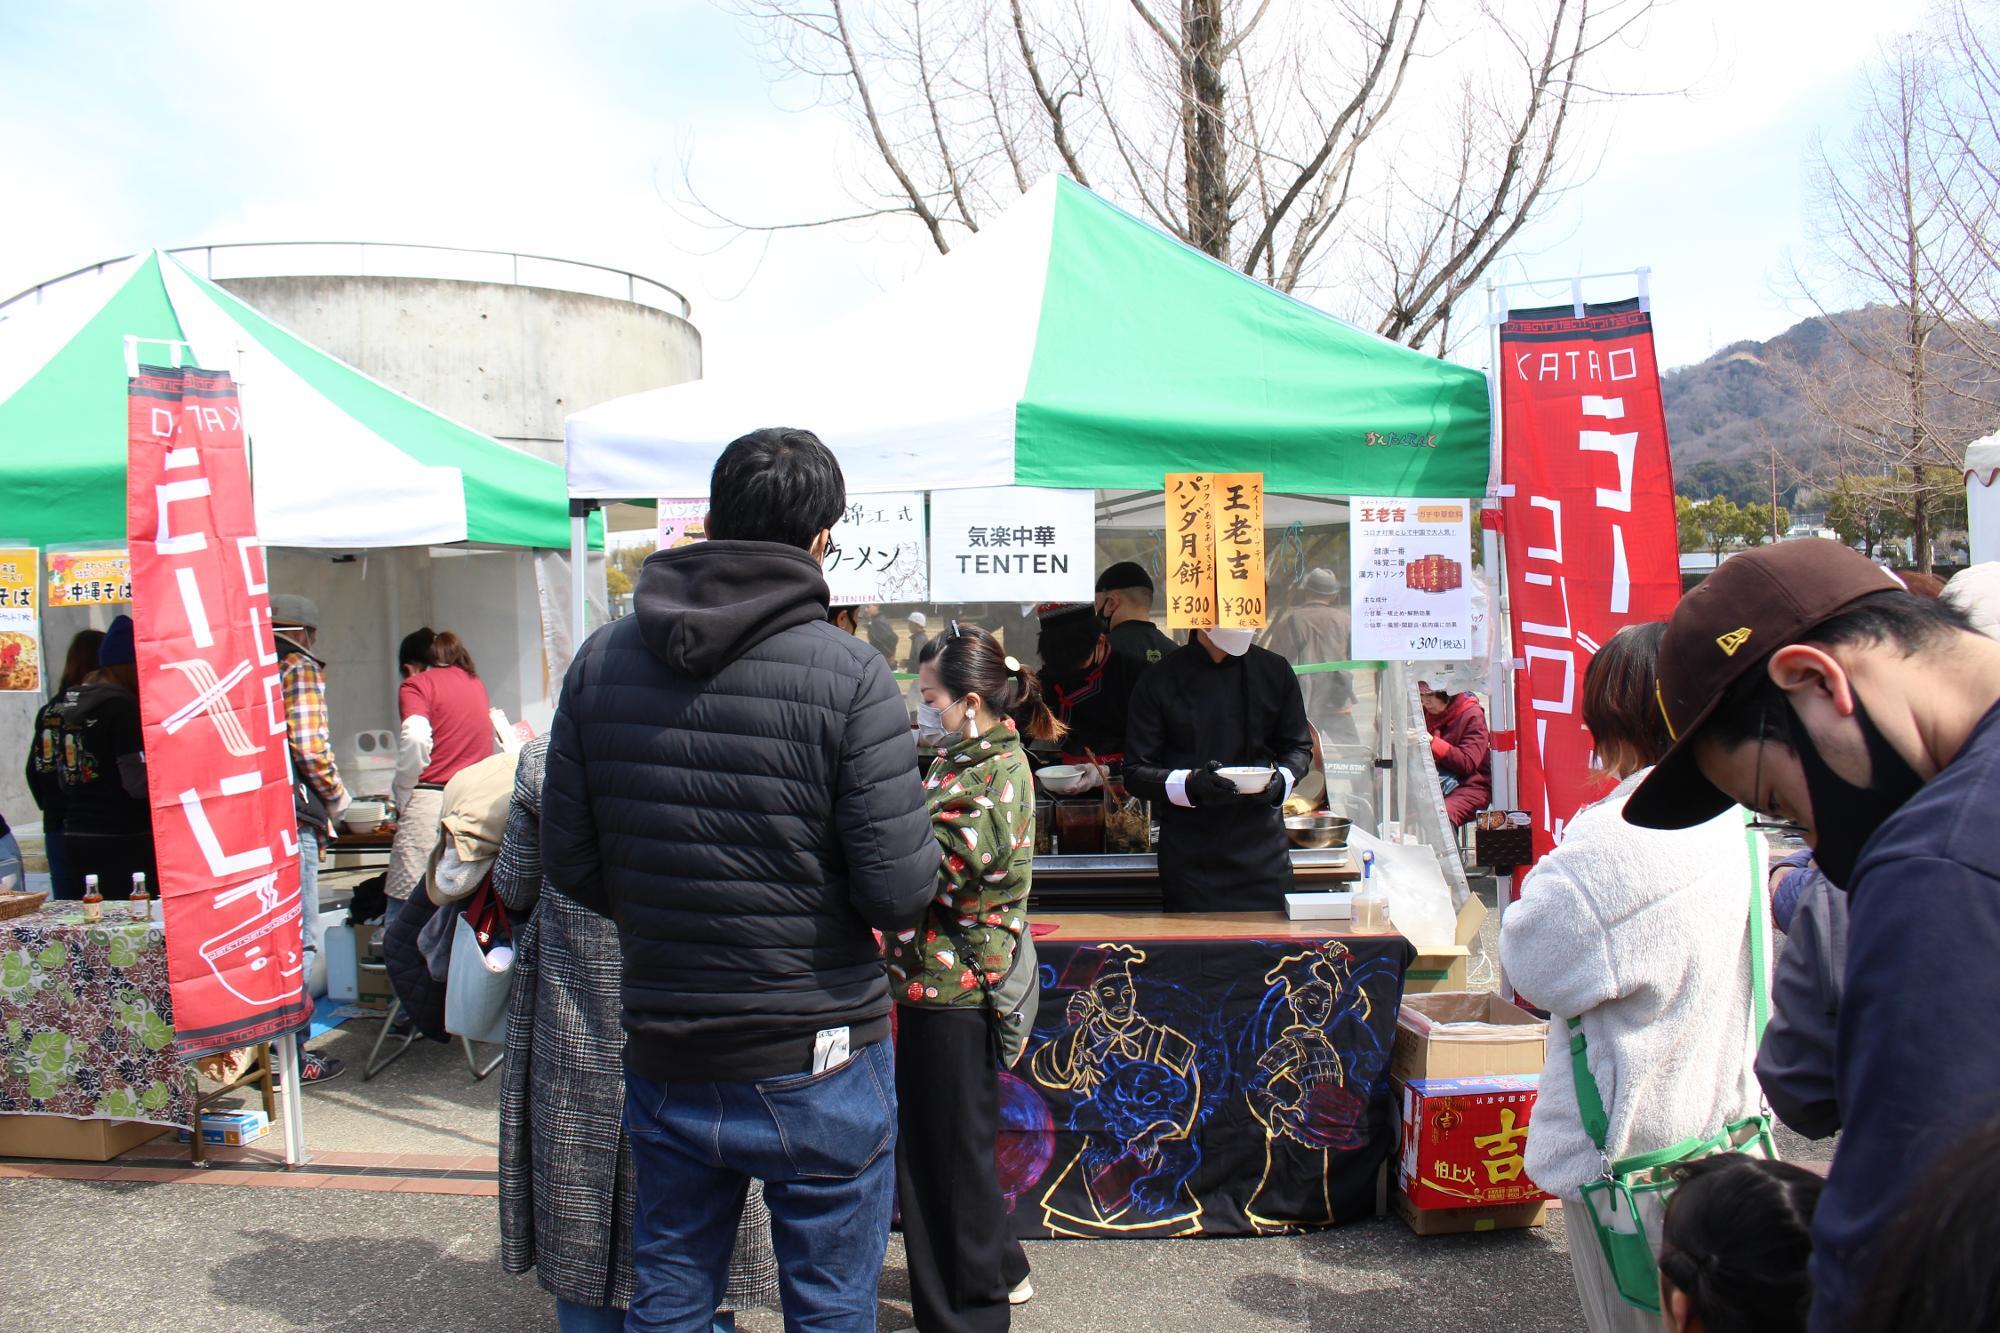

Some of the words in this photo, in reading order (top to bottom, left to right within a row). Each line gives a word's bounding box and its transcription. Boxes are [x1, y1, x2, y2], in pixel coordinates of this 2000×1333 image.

[1359, 506, 1407, 523] 王老吉
[968, 525, 1056, 548] 気楽中華
[1171, 475, 1205, 589] パンダ月餅
[1220, 484, 1253, 581] 王老吉
[1373, 547, 1405, 555] 健康一番
[955, 553, 1069, 574] TENTEN
[1373, 559, 1405, 567] 味覚二番
[1358, 570, 1405, 579] 漢方ドリンク
[1171, 595, 1210, 614] ¥300
[1222, 597, 1262, 617] ¥300
[1190, 617, 1212, 626] 税込
[1238, 617, 1260, 627] 税込
[1409, 636, 1438, 650] ¥300
[1473, 1107, 1528, 1184] 吉
[1434, 1159, 1476, 1186] 怕上火
